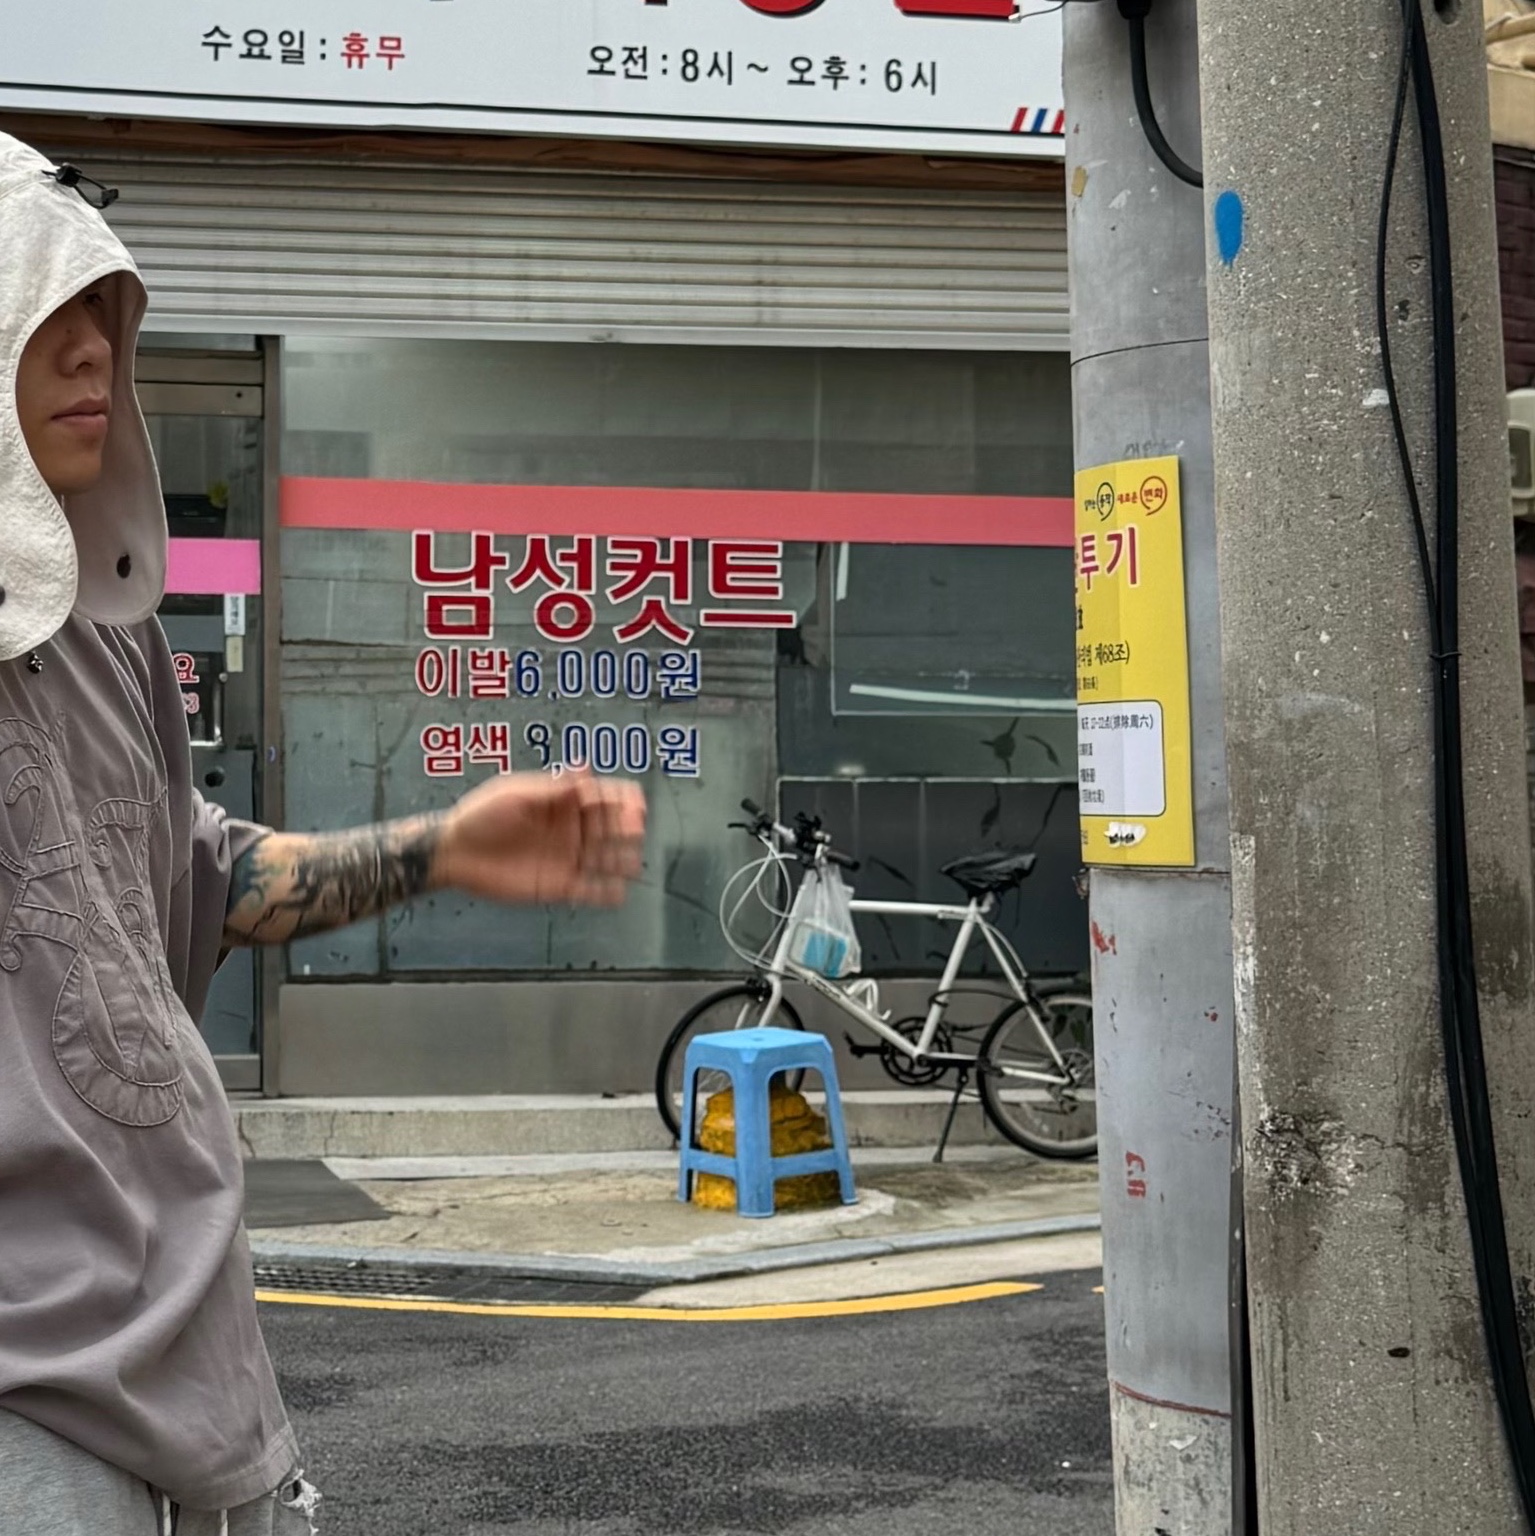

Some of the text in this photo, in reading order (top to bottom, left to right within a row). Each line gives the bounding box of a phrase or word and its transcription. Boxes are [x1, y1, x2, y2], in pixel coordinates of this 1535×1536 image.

[339, 32, 406, 71] 휴무
[411, 530, 798, 646] 남성컷트
[415, 645, 702, 702] 이발 6,000원
[418, 722, 511, 777] 염색
